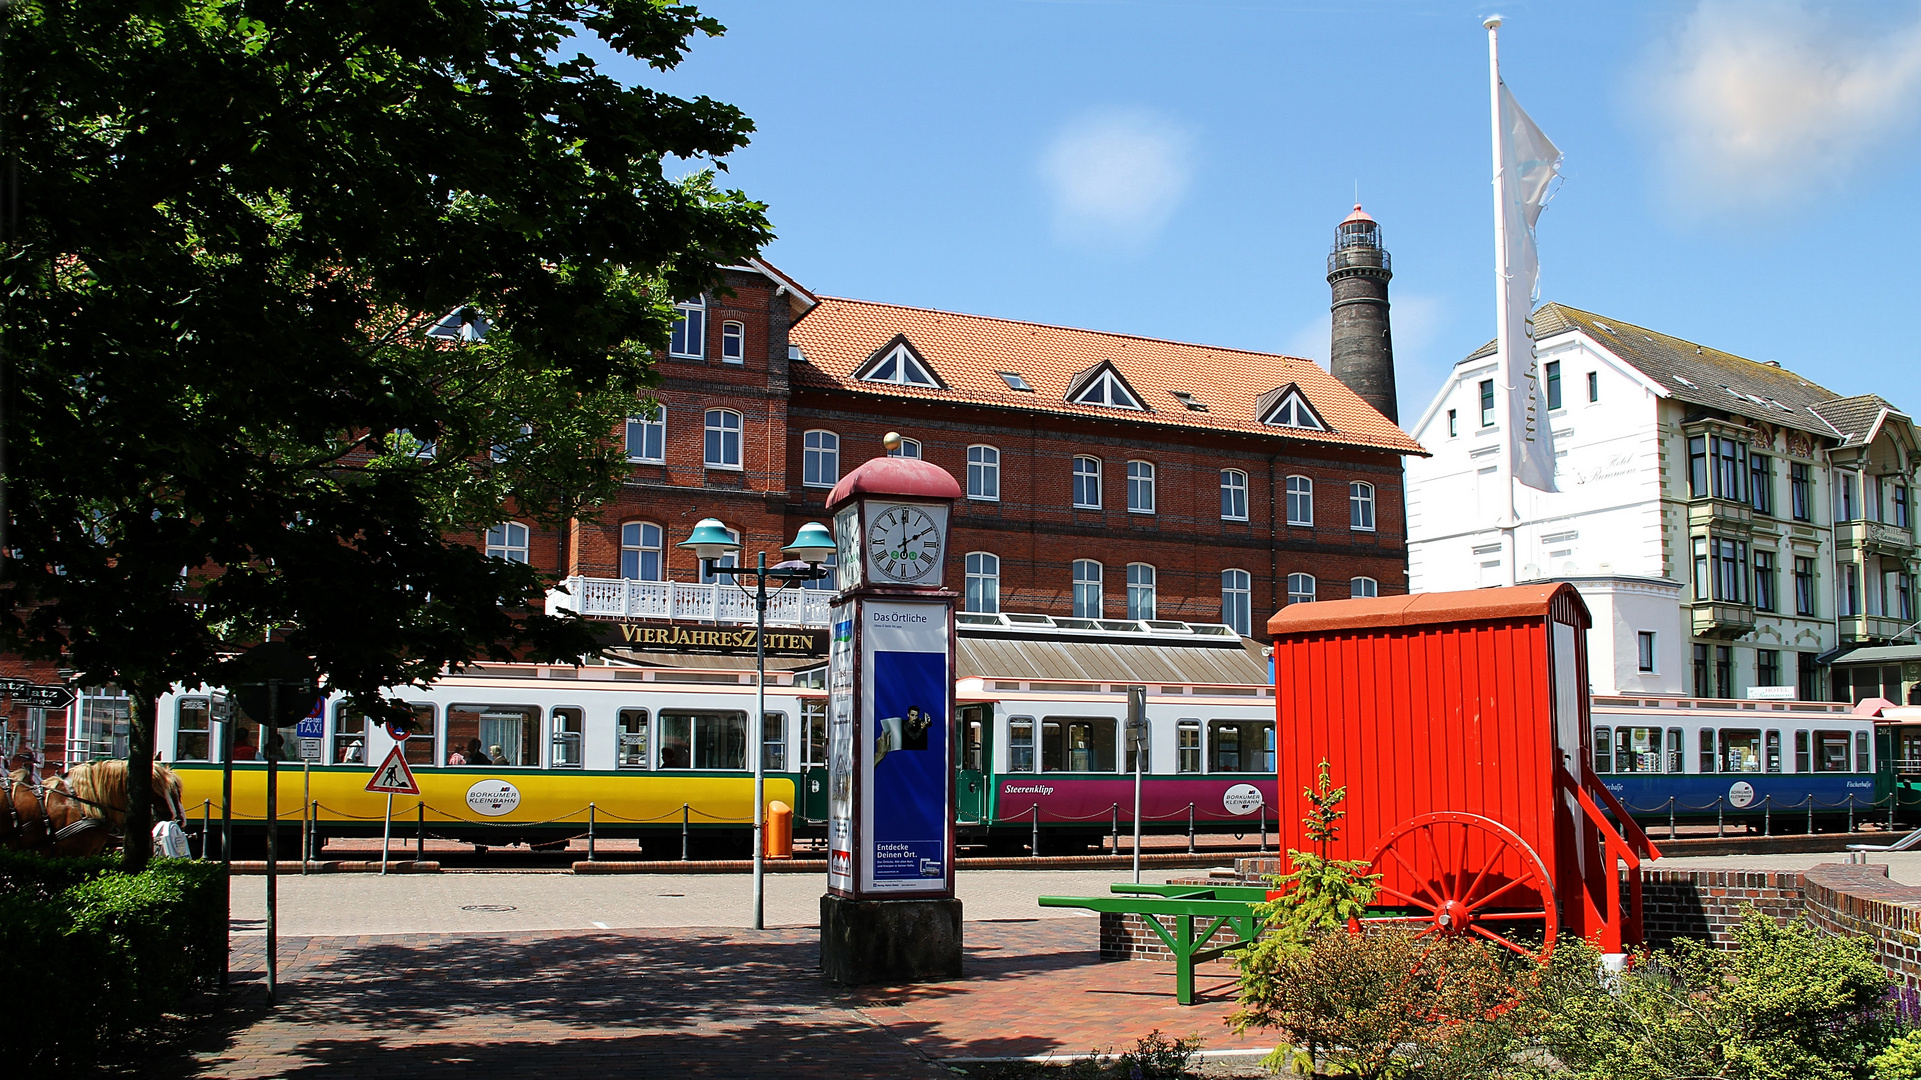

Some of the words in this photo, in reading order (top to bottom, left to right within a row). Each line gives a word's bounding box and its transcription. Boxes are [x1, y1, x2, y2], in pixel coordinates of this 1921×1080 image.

[873, 612, 890, 622] Das
[891, 611, 927, 623] Örtliche
[1004, 784, 1054, 796] Steerenklipp
[877, 843, 909, 851] Entdecke
[877, 851, 902, 859] Deinen
